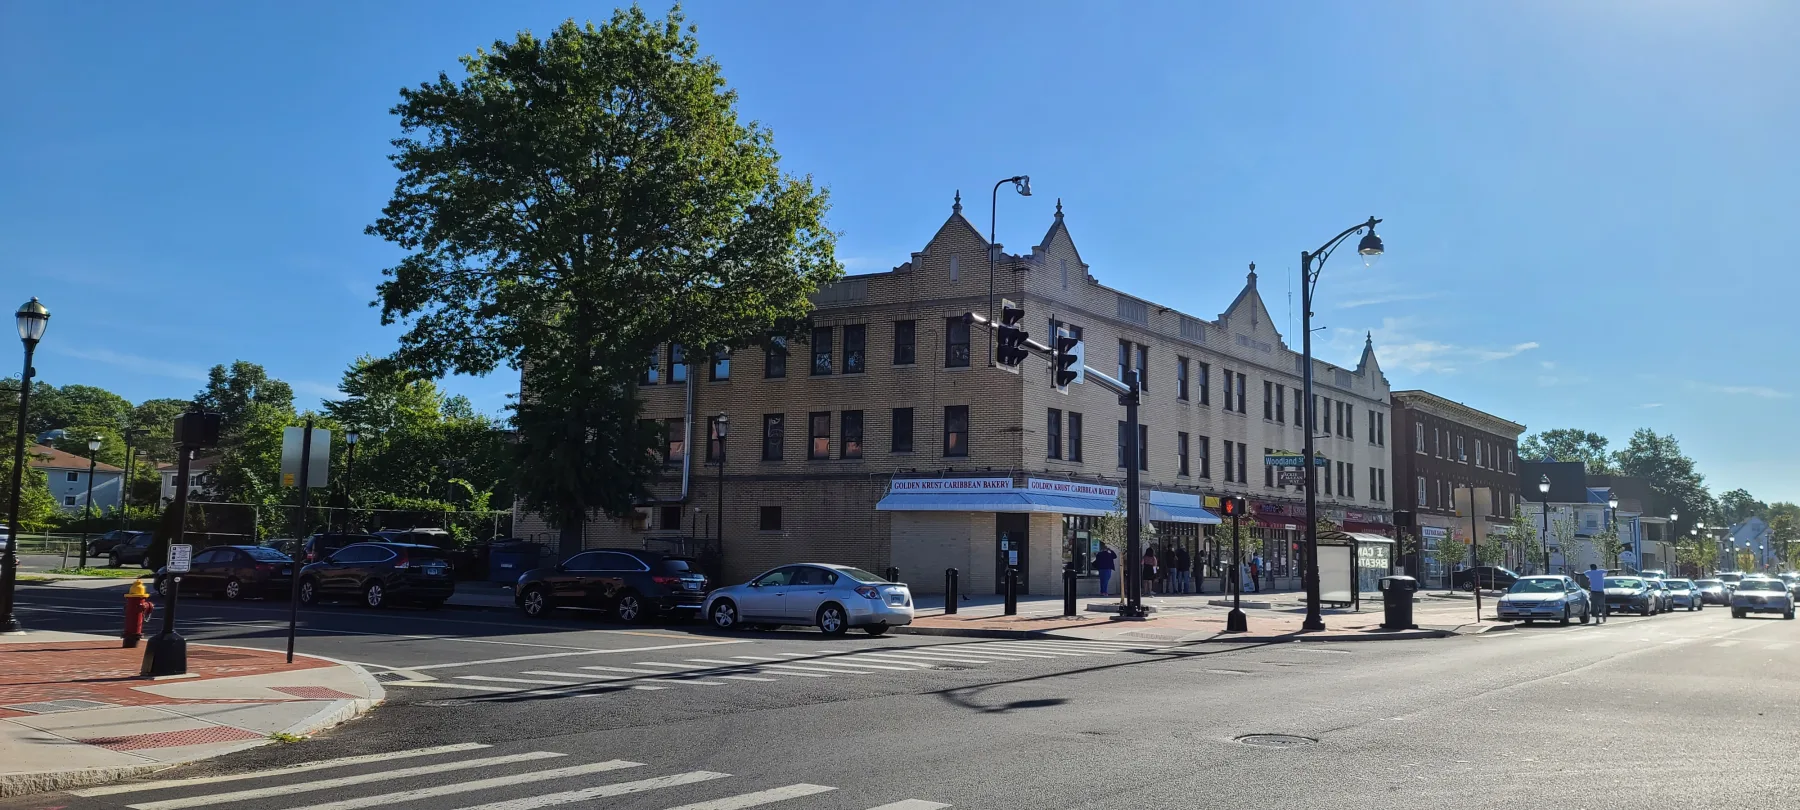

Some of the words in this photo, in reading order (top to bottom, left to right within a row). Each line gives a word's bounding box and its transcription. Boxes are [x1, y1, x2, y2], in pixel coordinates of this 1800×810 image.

[1265, 457, 1297, 465] Woodland
[894, 481, 920, 489] GOLDEN
[921, 481, 943, 489] KRUST
[944, 480, 982, 489] CARIBBEAN
[983, 480, 1010, 489] BAKERY
[1031, 481, 1053, 490] GOLDEN
[1054, 483, 1070, 491] KRUST
[1071, 484, 1098, 494] CARIBBEAN
[1098, 488, 1116, 496] BAKERY
